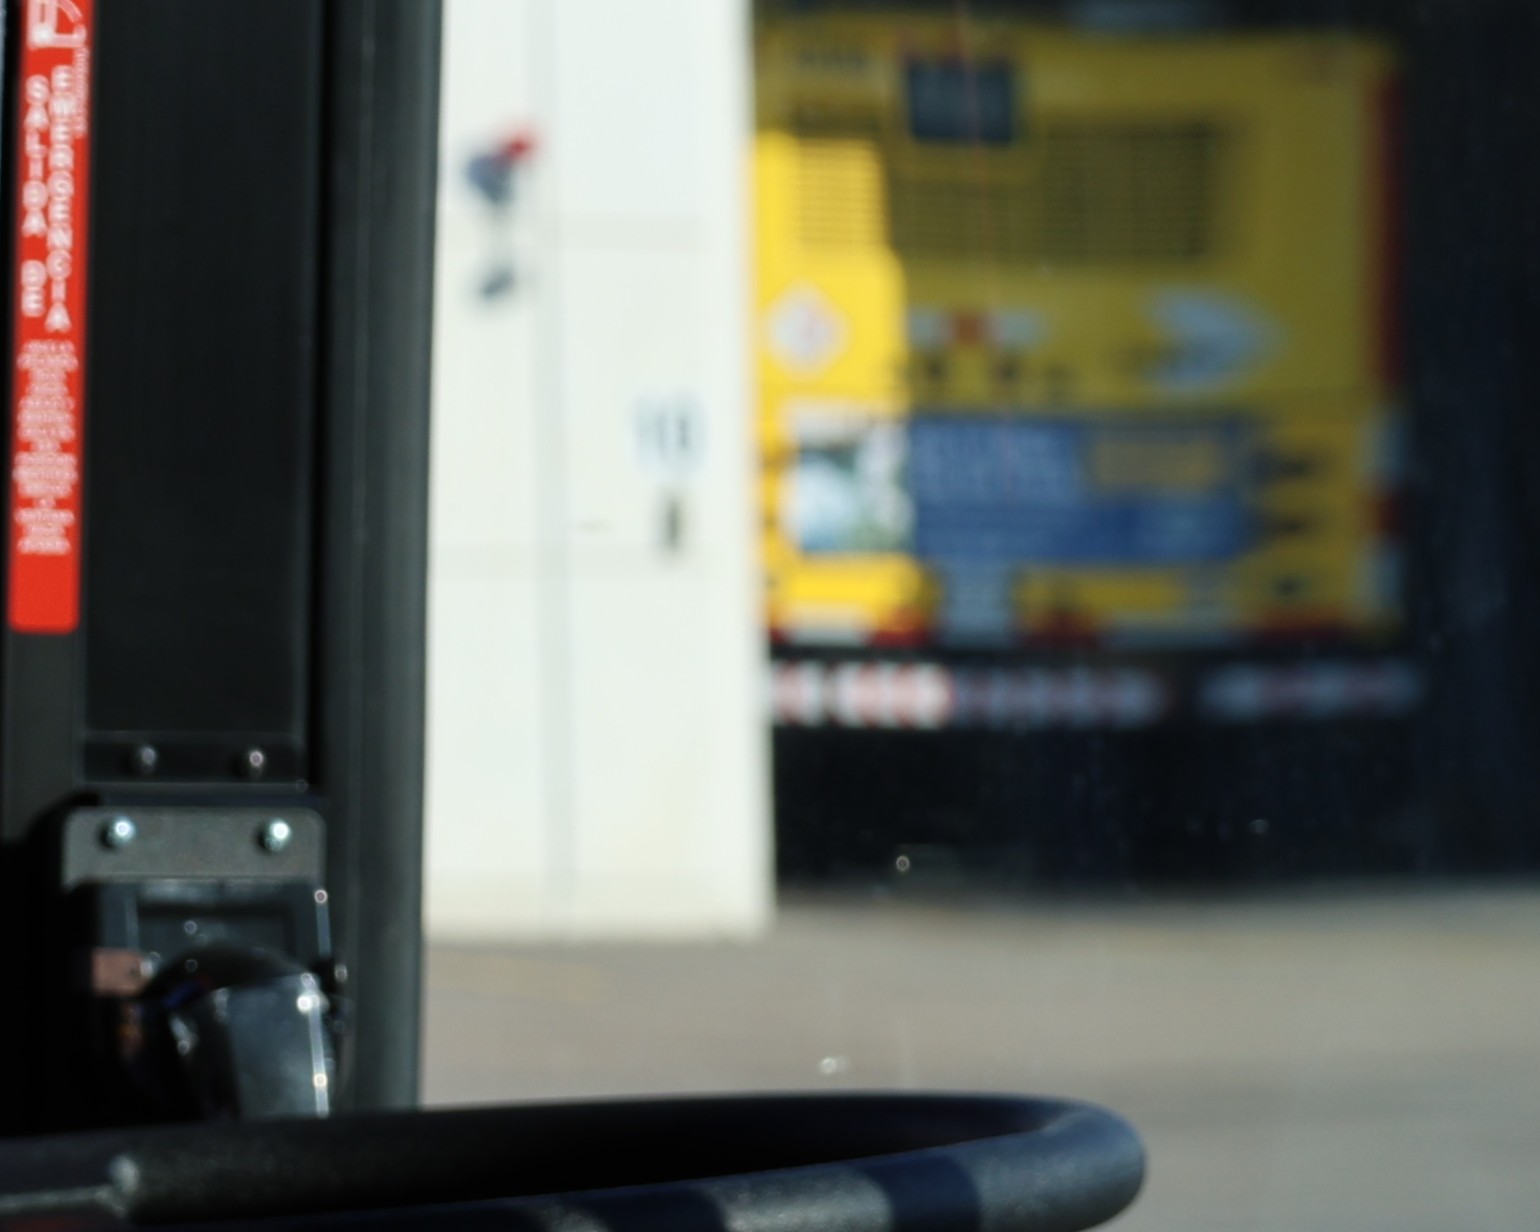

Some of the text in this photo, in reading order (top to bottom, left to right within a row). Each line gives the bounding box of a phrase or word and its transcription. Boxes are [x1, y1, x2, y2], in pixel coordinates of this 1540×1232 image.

[22, 74, 50, 238] SALIDA
[45, 65, 75, 334] EMERGENCIA
[21, 260, 47, 317] DE
